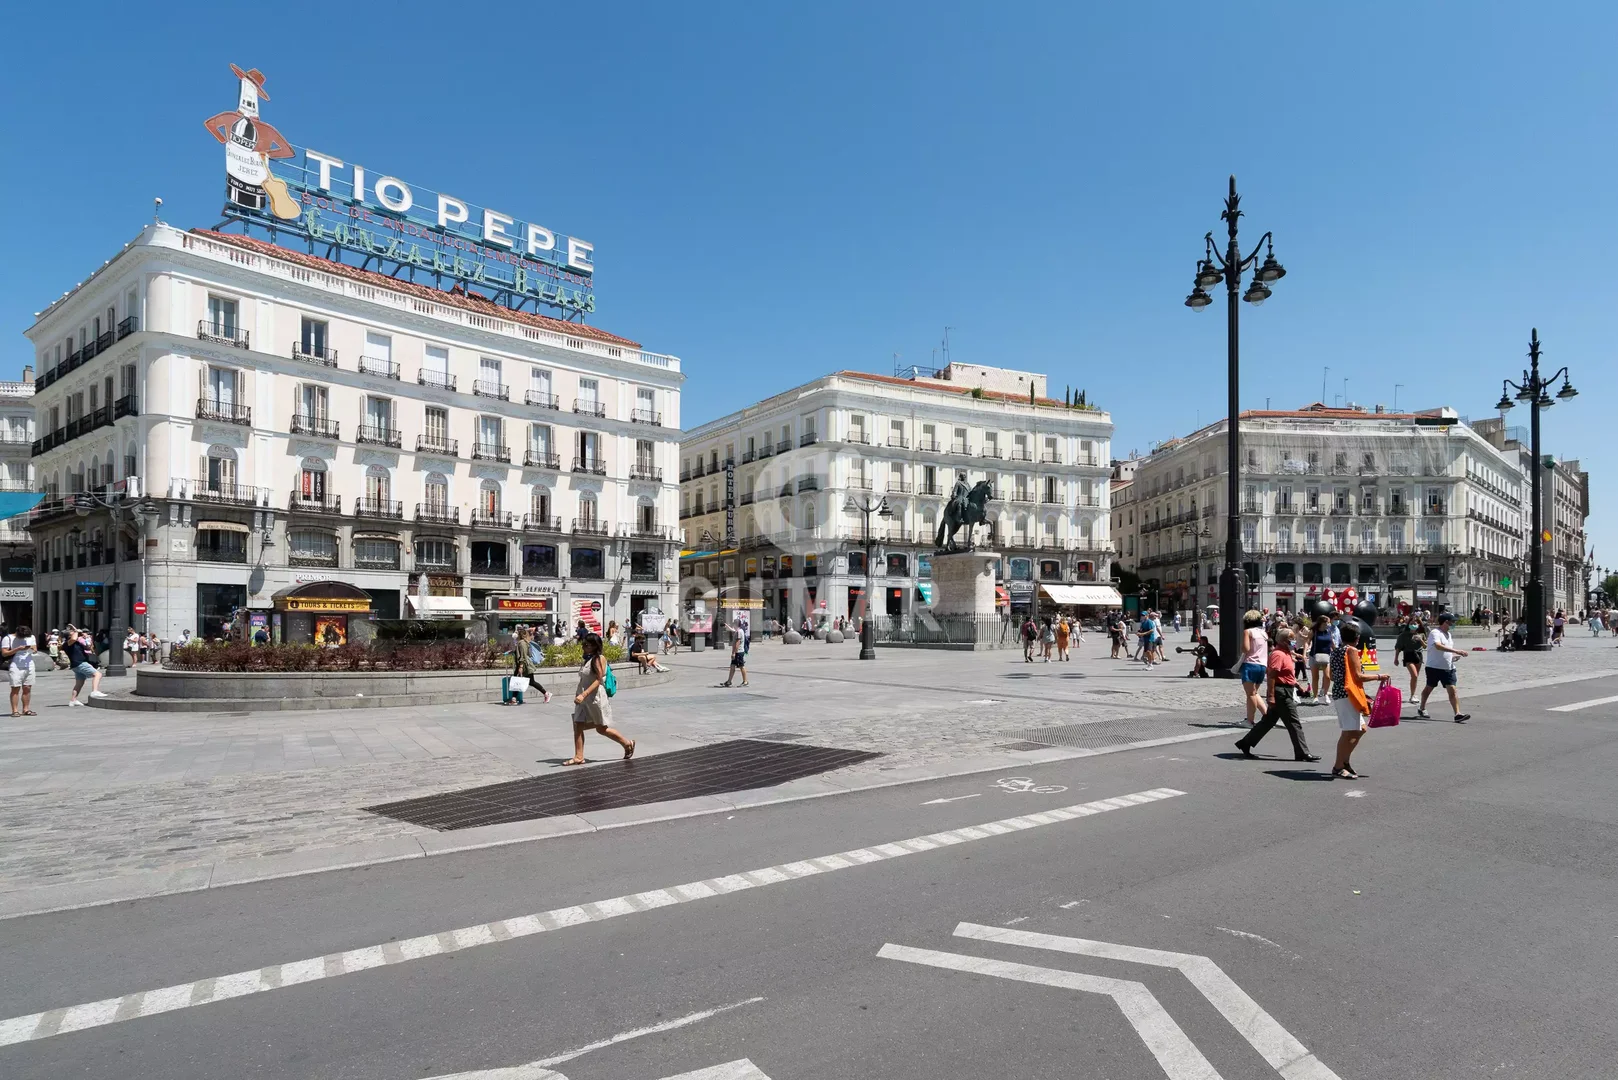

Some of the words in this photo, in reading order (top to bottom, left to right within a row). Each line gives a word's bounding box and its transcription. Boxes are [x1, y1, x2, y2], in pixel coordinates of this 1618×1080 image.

[301, 191, 342, 215] SOL
[350, 206, 374, 223] DE
[485, 247, 593, 288] EMBOTELLADO
[306, 148, 413, 212] TIO
[438, 193, 594, 273] PEPE
[306, 206, 485, 283] GONZALEZ
[515, 266, 596, 313] BYASS
